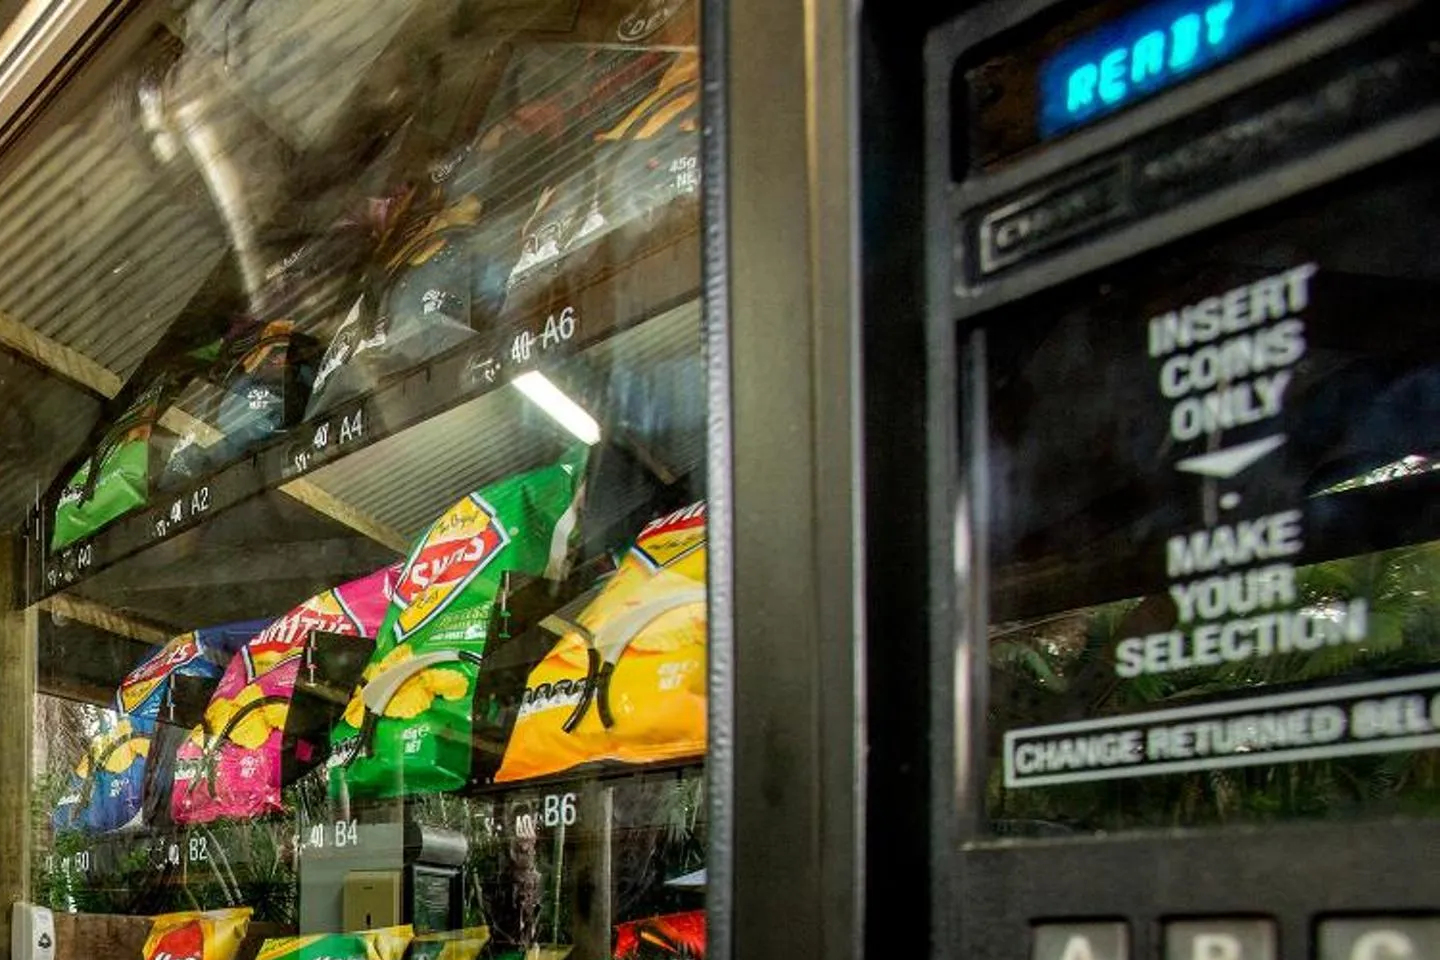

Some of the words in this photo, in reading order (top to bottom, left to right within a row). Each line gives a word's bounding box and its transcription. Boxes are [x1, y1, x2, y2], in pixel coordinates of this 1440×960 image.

[1067, 2, 1234, 113] READY
[543, 306, 575, 349] A6
[1148, 262, 1319, 356] INSERT
[1160, 318, 1306, 400] COINS
[340, 407, 362, 444] A4
[1170, 370, 1293, 441] ONLY
[191, 487, 209, 515] A2
[1166, 509, 1303, 577] MAKE
[1167, 563, 1296, 623] YOUR
[1115, 598, 1370, 678] SELECTION
[1015, 730, 1144, 775] CHANGE
[1147, 705, 1346, 760] RETURNED
[1352, 693, 1440, 739] BEL
[335, 818, 358, 848] B4
[544, 792, 577, 827] B6
[189, 836, 208, 861] B2
